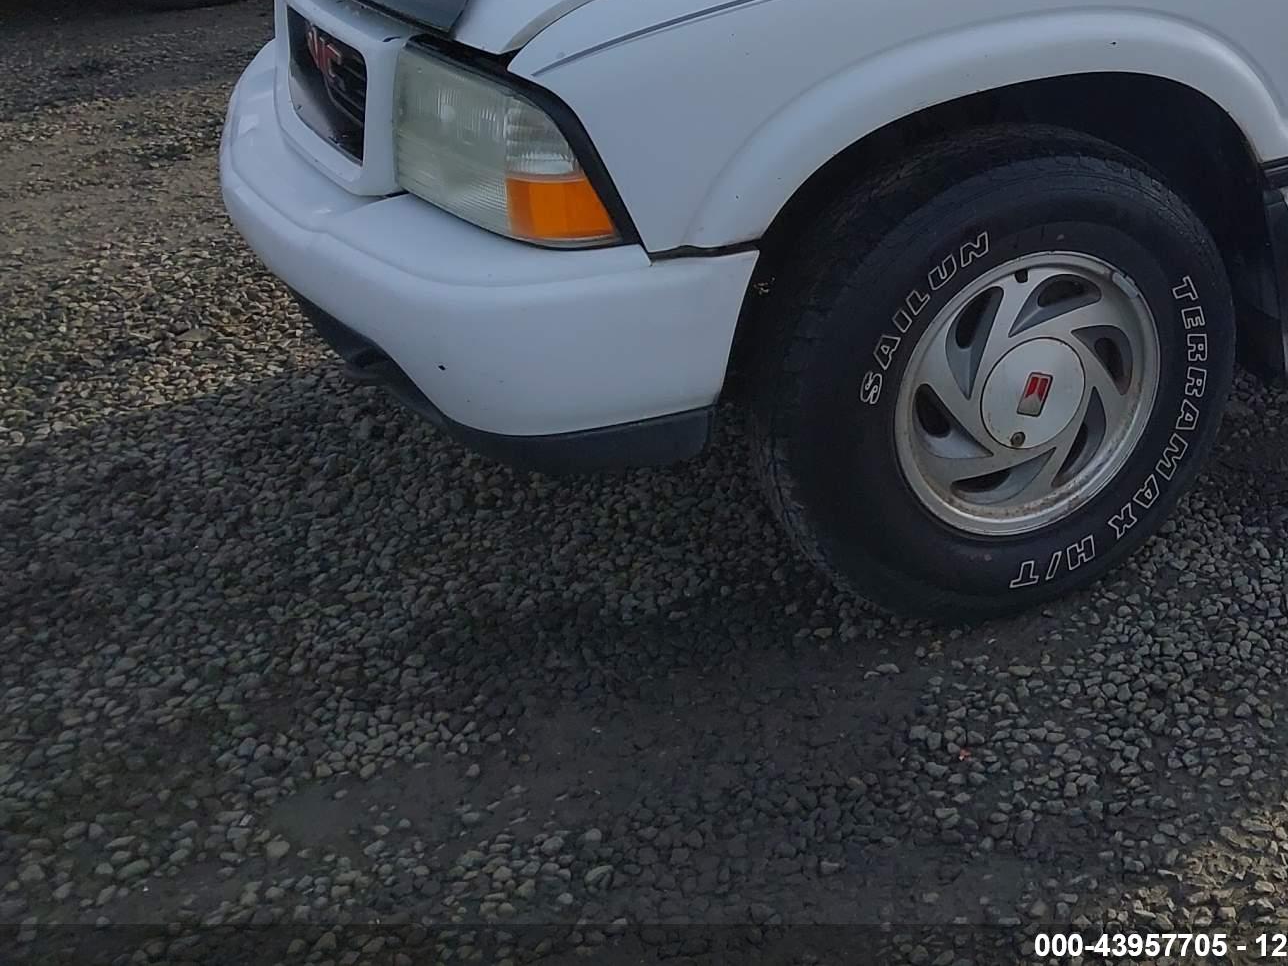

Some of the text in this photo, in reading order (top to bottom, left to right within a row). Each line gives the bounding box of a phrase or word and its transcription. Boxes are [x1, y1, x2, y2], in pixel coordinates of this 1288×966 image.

[860, 231, 989, 405] SAILUN
[1009, 276, 1207, 589] TERRAMAX H/T
